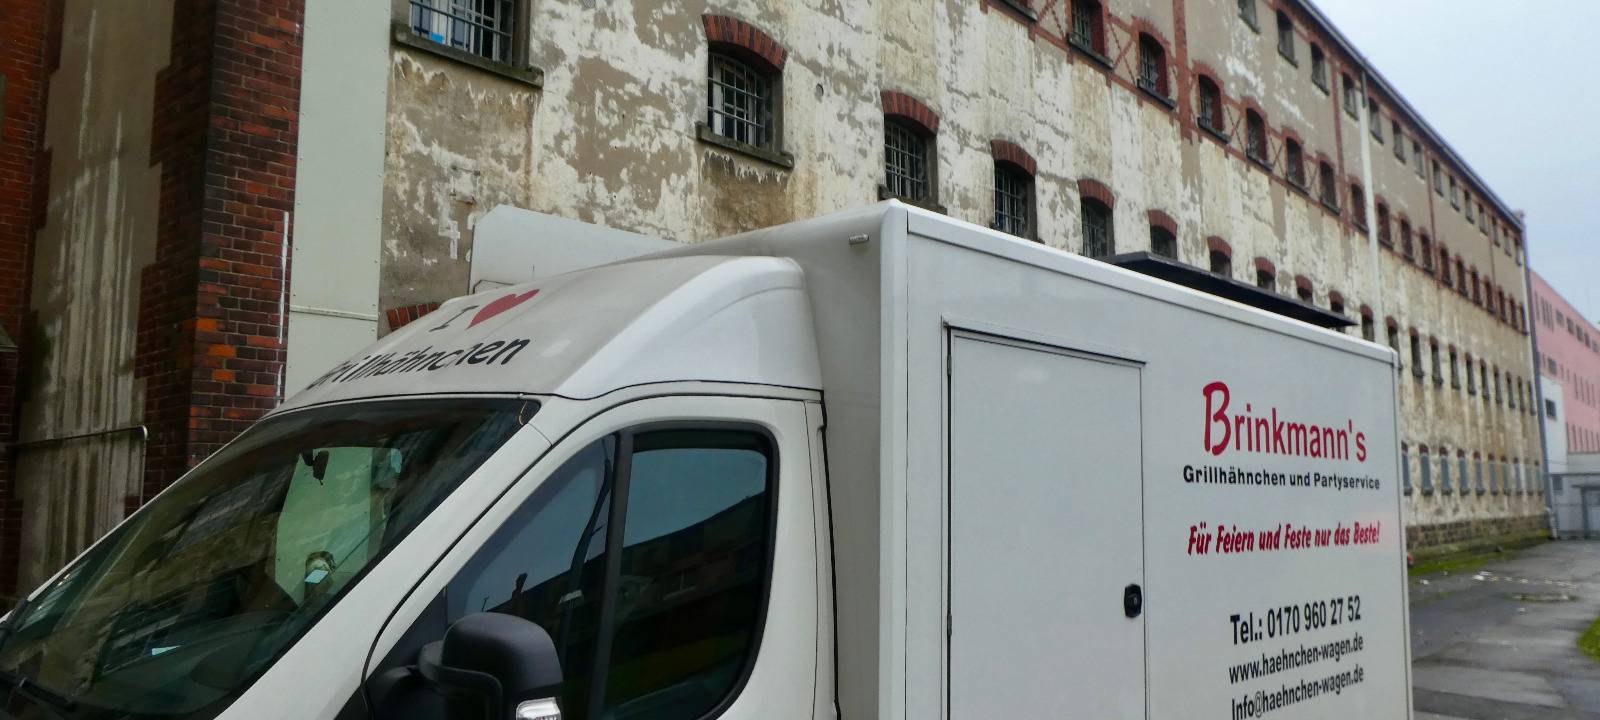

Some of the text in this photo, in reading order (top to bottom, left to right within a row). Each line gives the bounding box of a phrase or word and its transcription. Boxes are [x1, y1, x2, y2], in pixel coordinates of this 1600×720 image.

[429, 305, 479, 332] I
[1203, 381, 1366, 462] Brinkmann's
[1183, 465, 1380, 490] Grillhähnchen und Partyservice
[1187, 520, 1380, 556] Für Feiern und Feste nur das Beste!
[1230, 594, 1361, 645] Tel.: 0170 960 27 52
[1229, 632, 1364, 684] www.haehnchen-wagen.de
[1231, 664, 1364, 720] Info@haehnchen-wagen.de
